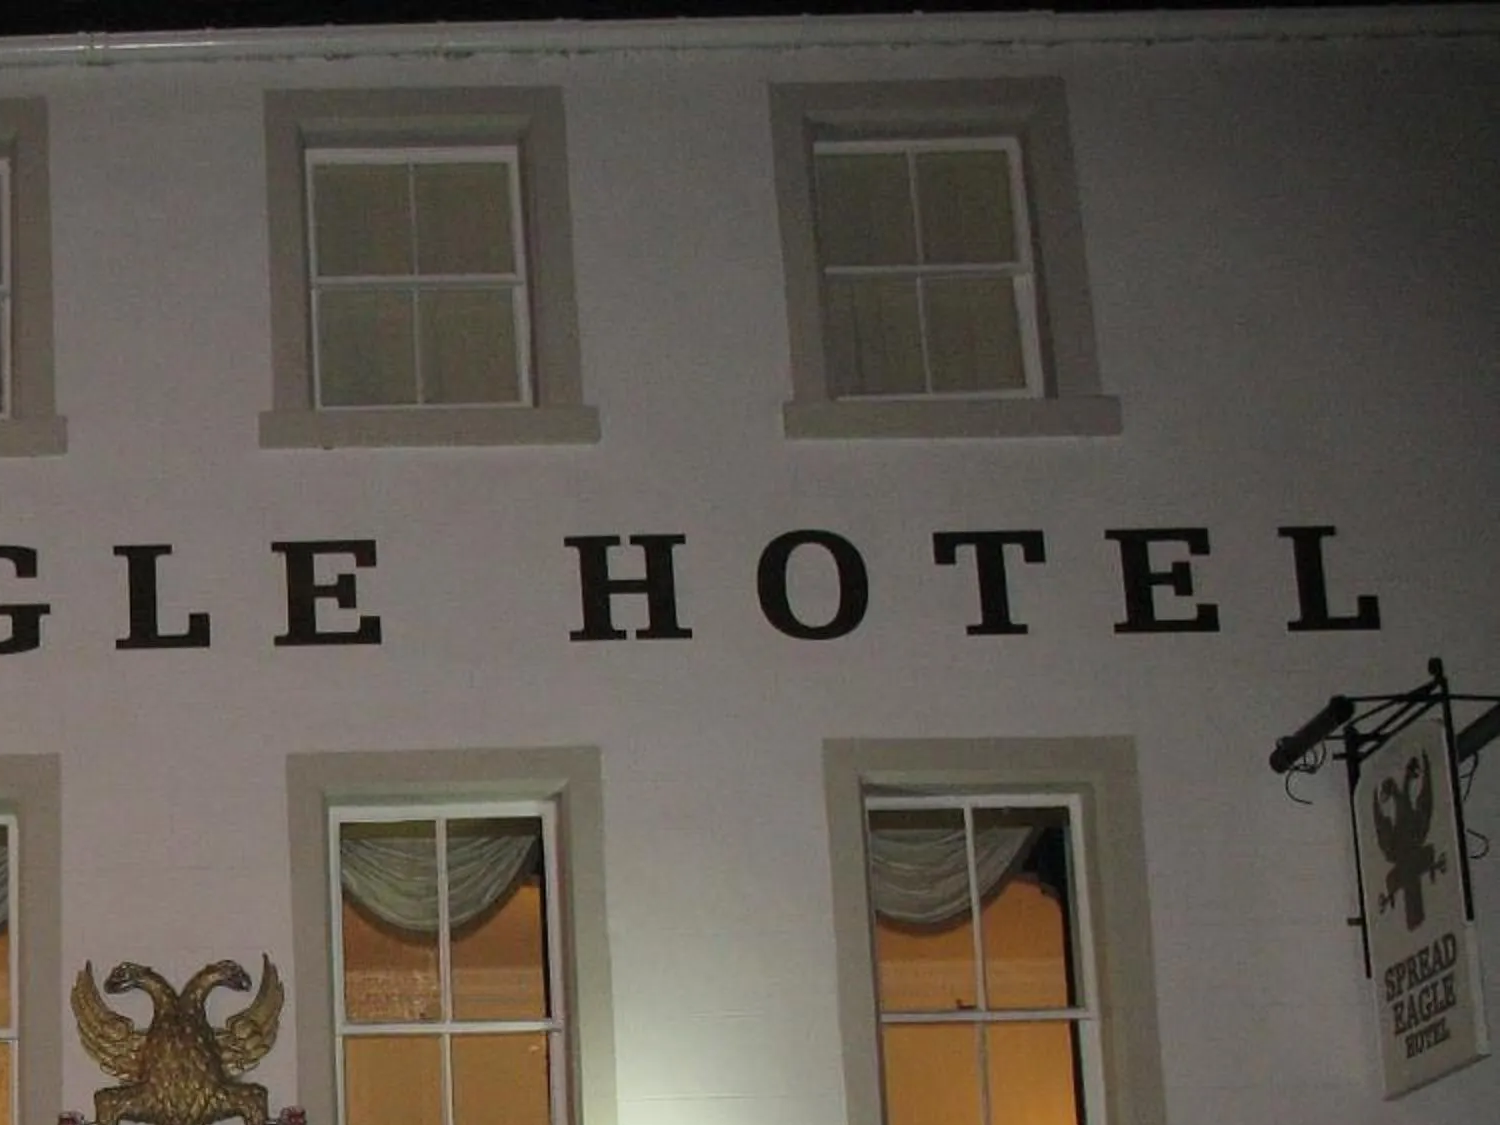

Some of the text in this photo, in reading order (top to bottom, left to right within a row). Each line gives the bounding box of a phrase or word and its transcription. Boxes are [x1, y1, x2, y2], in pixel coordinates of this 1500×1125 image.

[563, 525, 1382, 641] HOTEL
[1384, 933, 1457, 1002] SPREAD
[1393, 972, 1457, 1036] EAGLE
[1405, 1017, 1451, 1059] HOTEL
